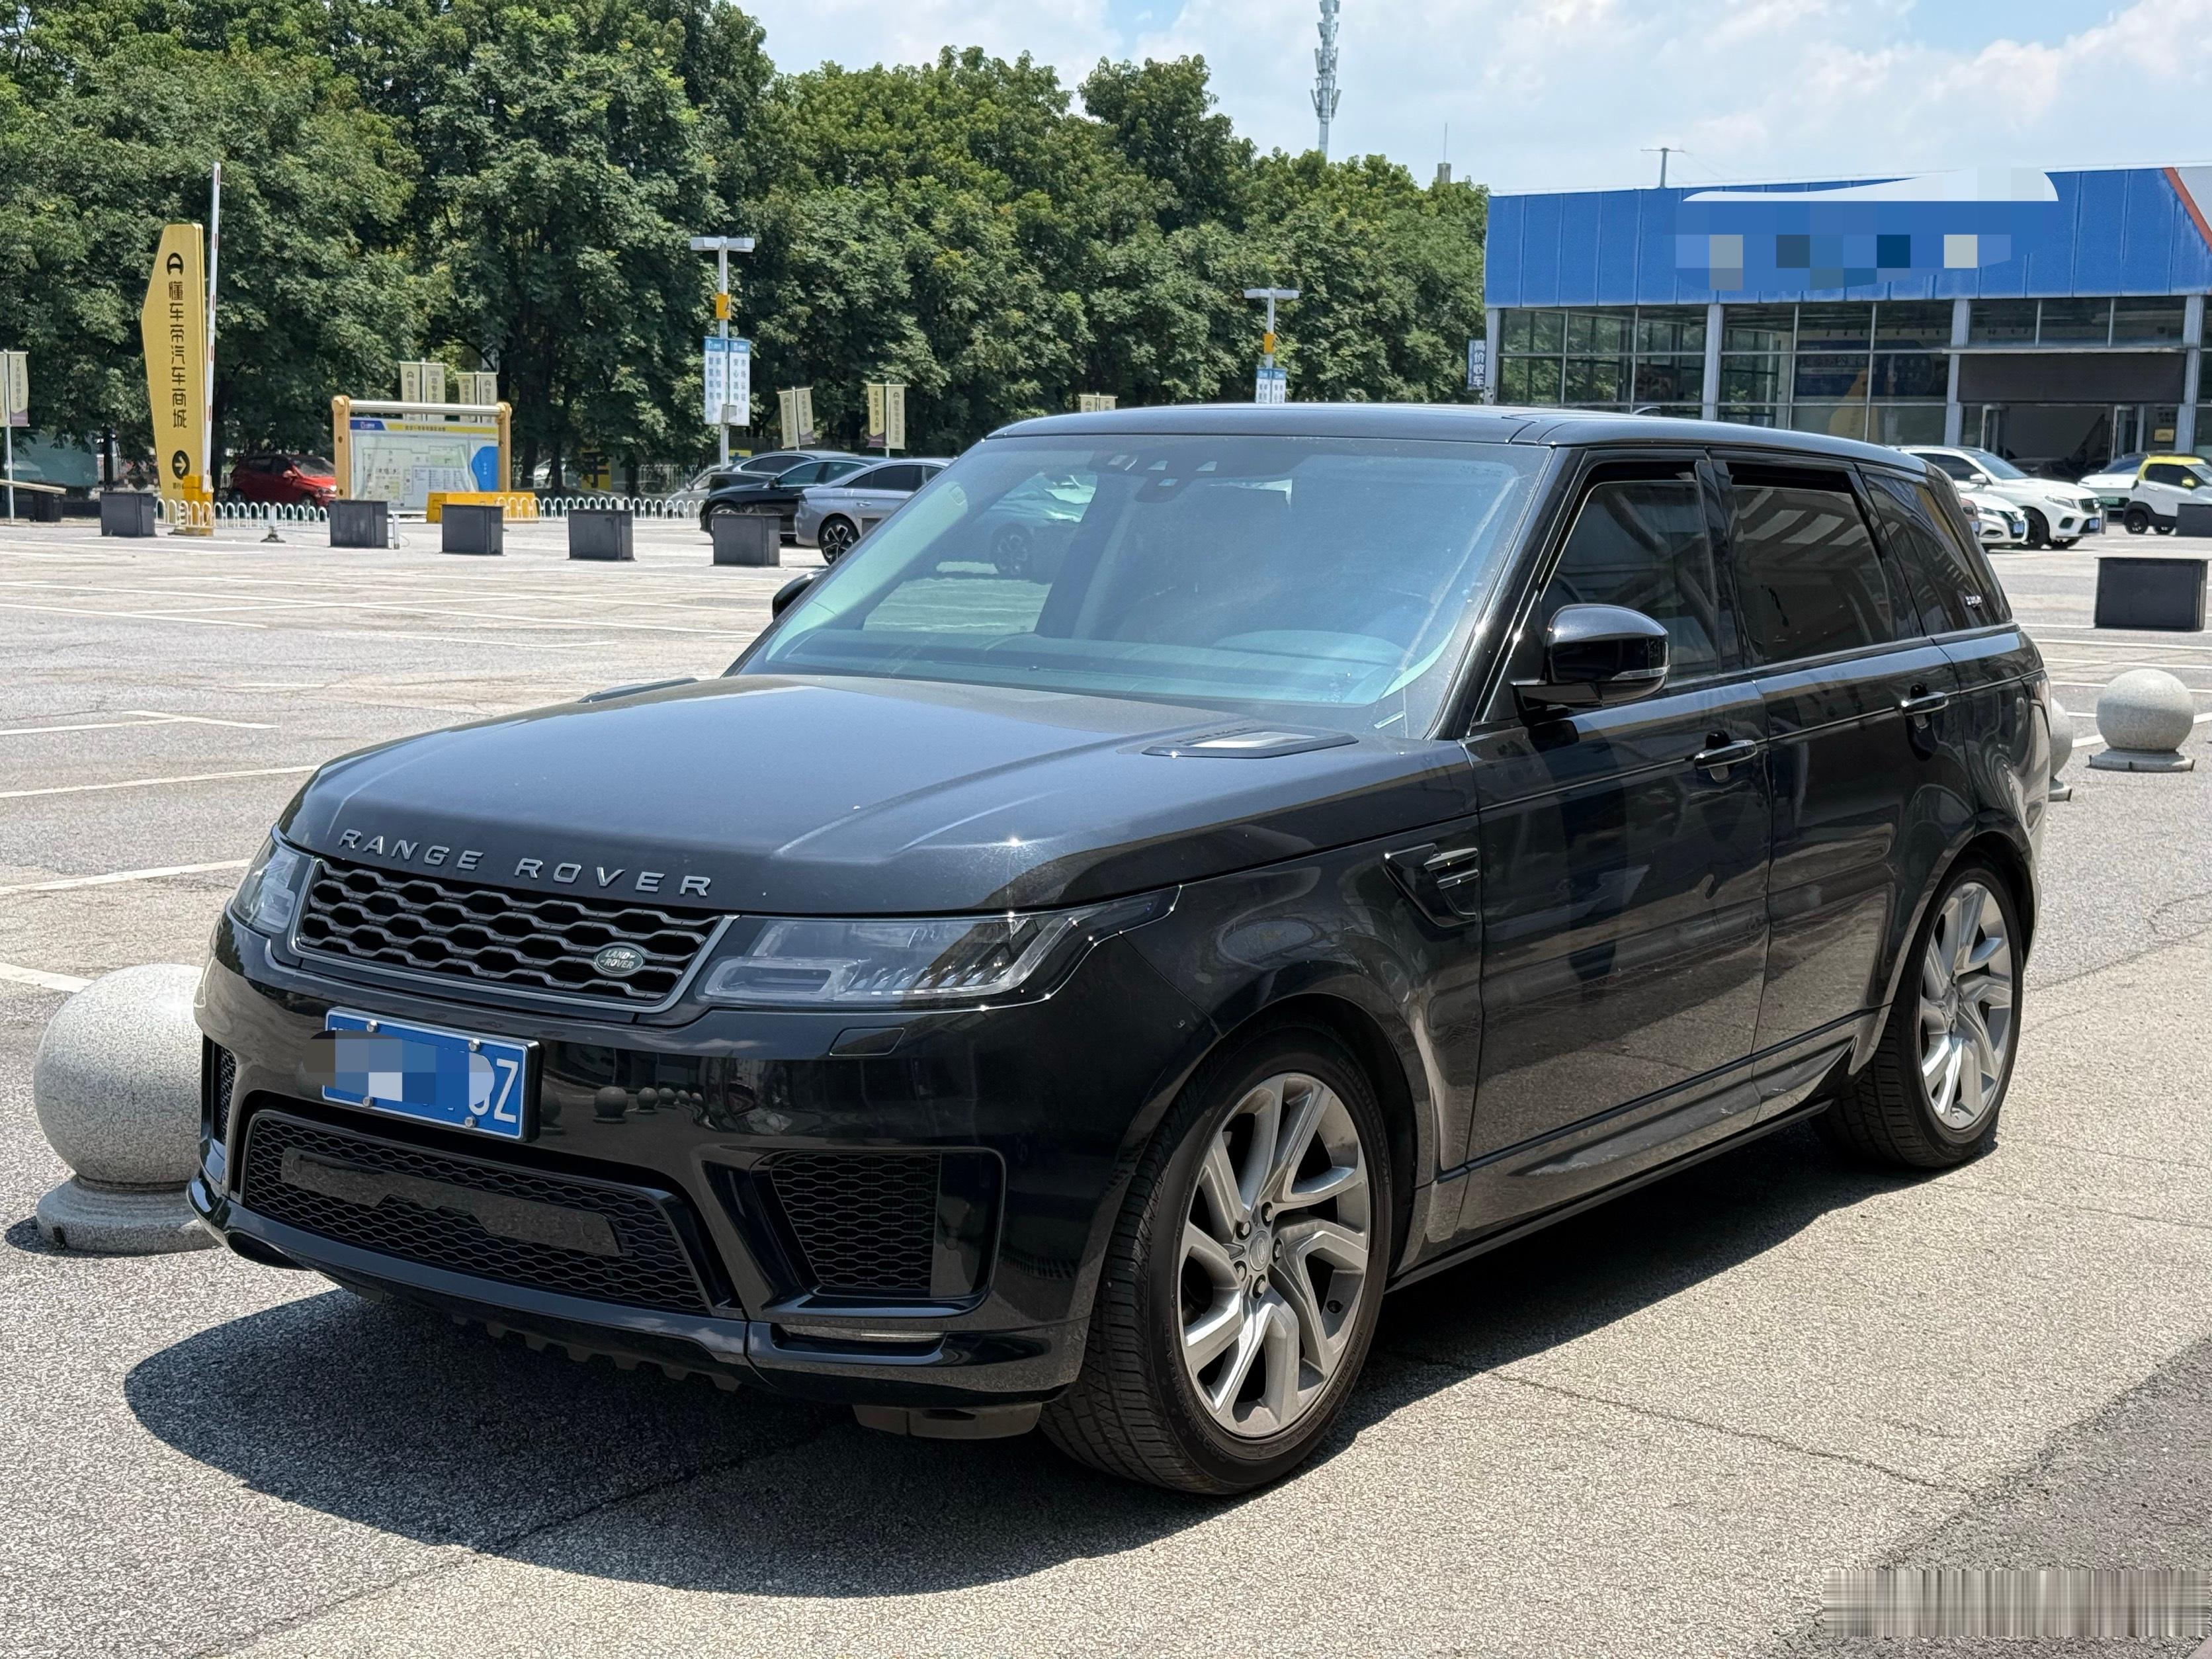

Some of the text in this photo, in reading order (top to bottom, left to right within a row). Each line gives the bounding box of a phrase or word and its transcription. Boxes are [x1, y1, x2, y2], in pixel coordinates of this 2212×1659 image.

[169, 281, 187, 429] 懂车帝汽车商城
[1472, 341, 1486, 387] 高价收车
[338, 828, 712, 898] RANGE ROVER
[603, 958, 635, 970] ROVER
[605, 950, 632, 959] LAND
